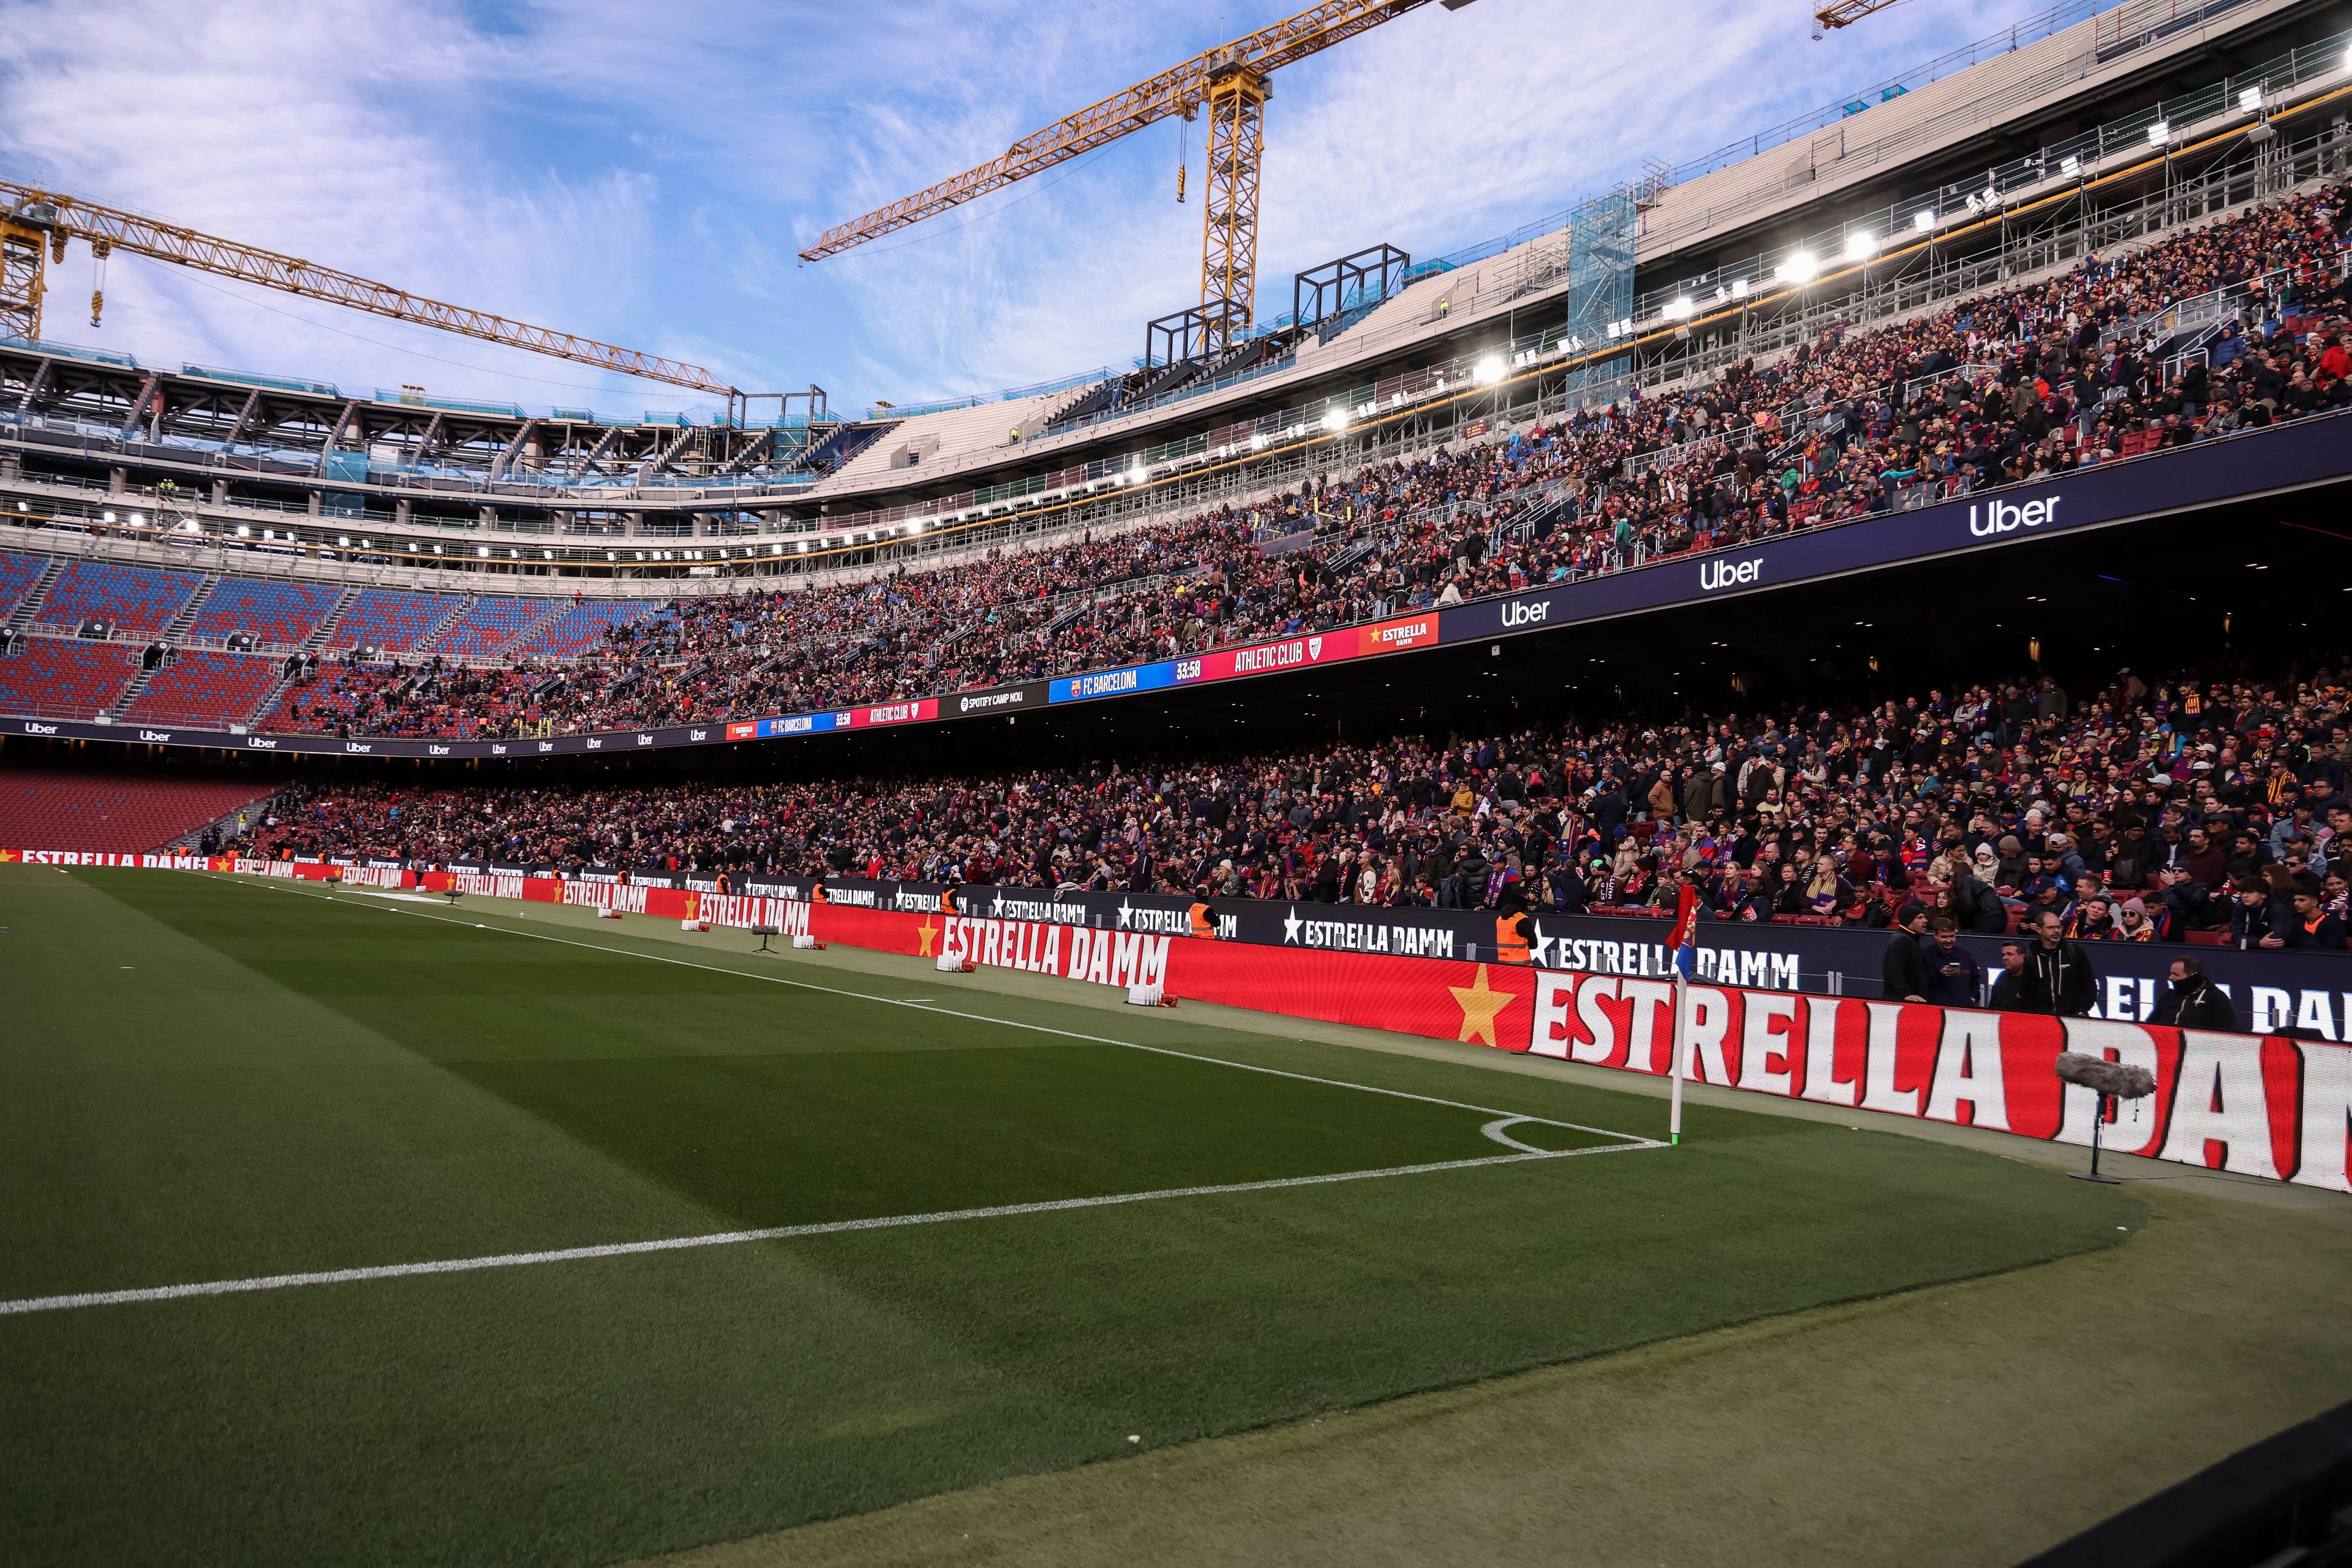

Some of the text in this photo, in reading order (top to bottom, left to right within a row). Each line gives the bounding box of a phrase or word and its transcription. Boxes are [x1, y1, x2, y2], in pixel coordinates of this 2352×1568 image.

[1970, 496, 2060, 536] Uber
[1700, 558, 1763, 590] Uber
[1502, 600, 1550, 627] Uber
[1382, 623, 1426, 642] ESTRELLA
[1396, 638, 1412, 647] DAMM
[1235, 641, 1303, 673] ATHLETIC CLUB
[1176, 660, 1201, 680] 33:58
[1083, 670, 1137, 695] FC BARCELONA
[969, 691, 1023, 708] SPOTIFY CAMP NOU
[836, 713, 851, 726] 33:58
[870, 704, 908, 723] ATHLETIC CLUB
[25, 723, 58, 734] Uber
[778, 717, 812, 733] FC BARCELONA
[140, 730, 171, 741] Uber
[248, 737, 277, 748] Uber
[587, 738, 602, 748] Uber
[638, 734, 653, 745] Uber
[690, 729, 706, 741] Uber
[346, 743, 371, 753] Uber
[429, 745, 450, 755] Uber
[492, 744, 507, 754] Uber
[539, 741, 553, 752] Uber
[142, 854, 209, 871] DAMM
[234, 858, 294, 878] ESTRELLA DAMM
[342, 867, 402, 887] ESTRELLA DAMM
[455, 874, 524, 899] ESTRELLA DAMM
[563, 881, 648, 914] ESTRELLA DAMM
[779, 885, 798, 899] DAMM
[853, 890, 874, 906] DAMM
[699, 893, 811, 937] ESTRELLA DAMM
[1006, 900, 1086, 924] ESTRELLA DAMM
[1305, 920, 1454, 958] ESTRELLA DAMM
[943, 915, 1171, 994] ESTRELLA DAMM
[1696, 947, 1799, 990] DAMM
[2251, 986, 2352, 1042] DA
[1529, 971, 2012, 1131] ESTRELLA
